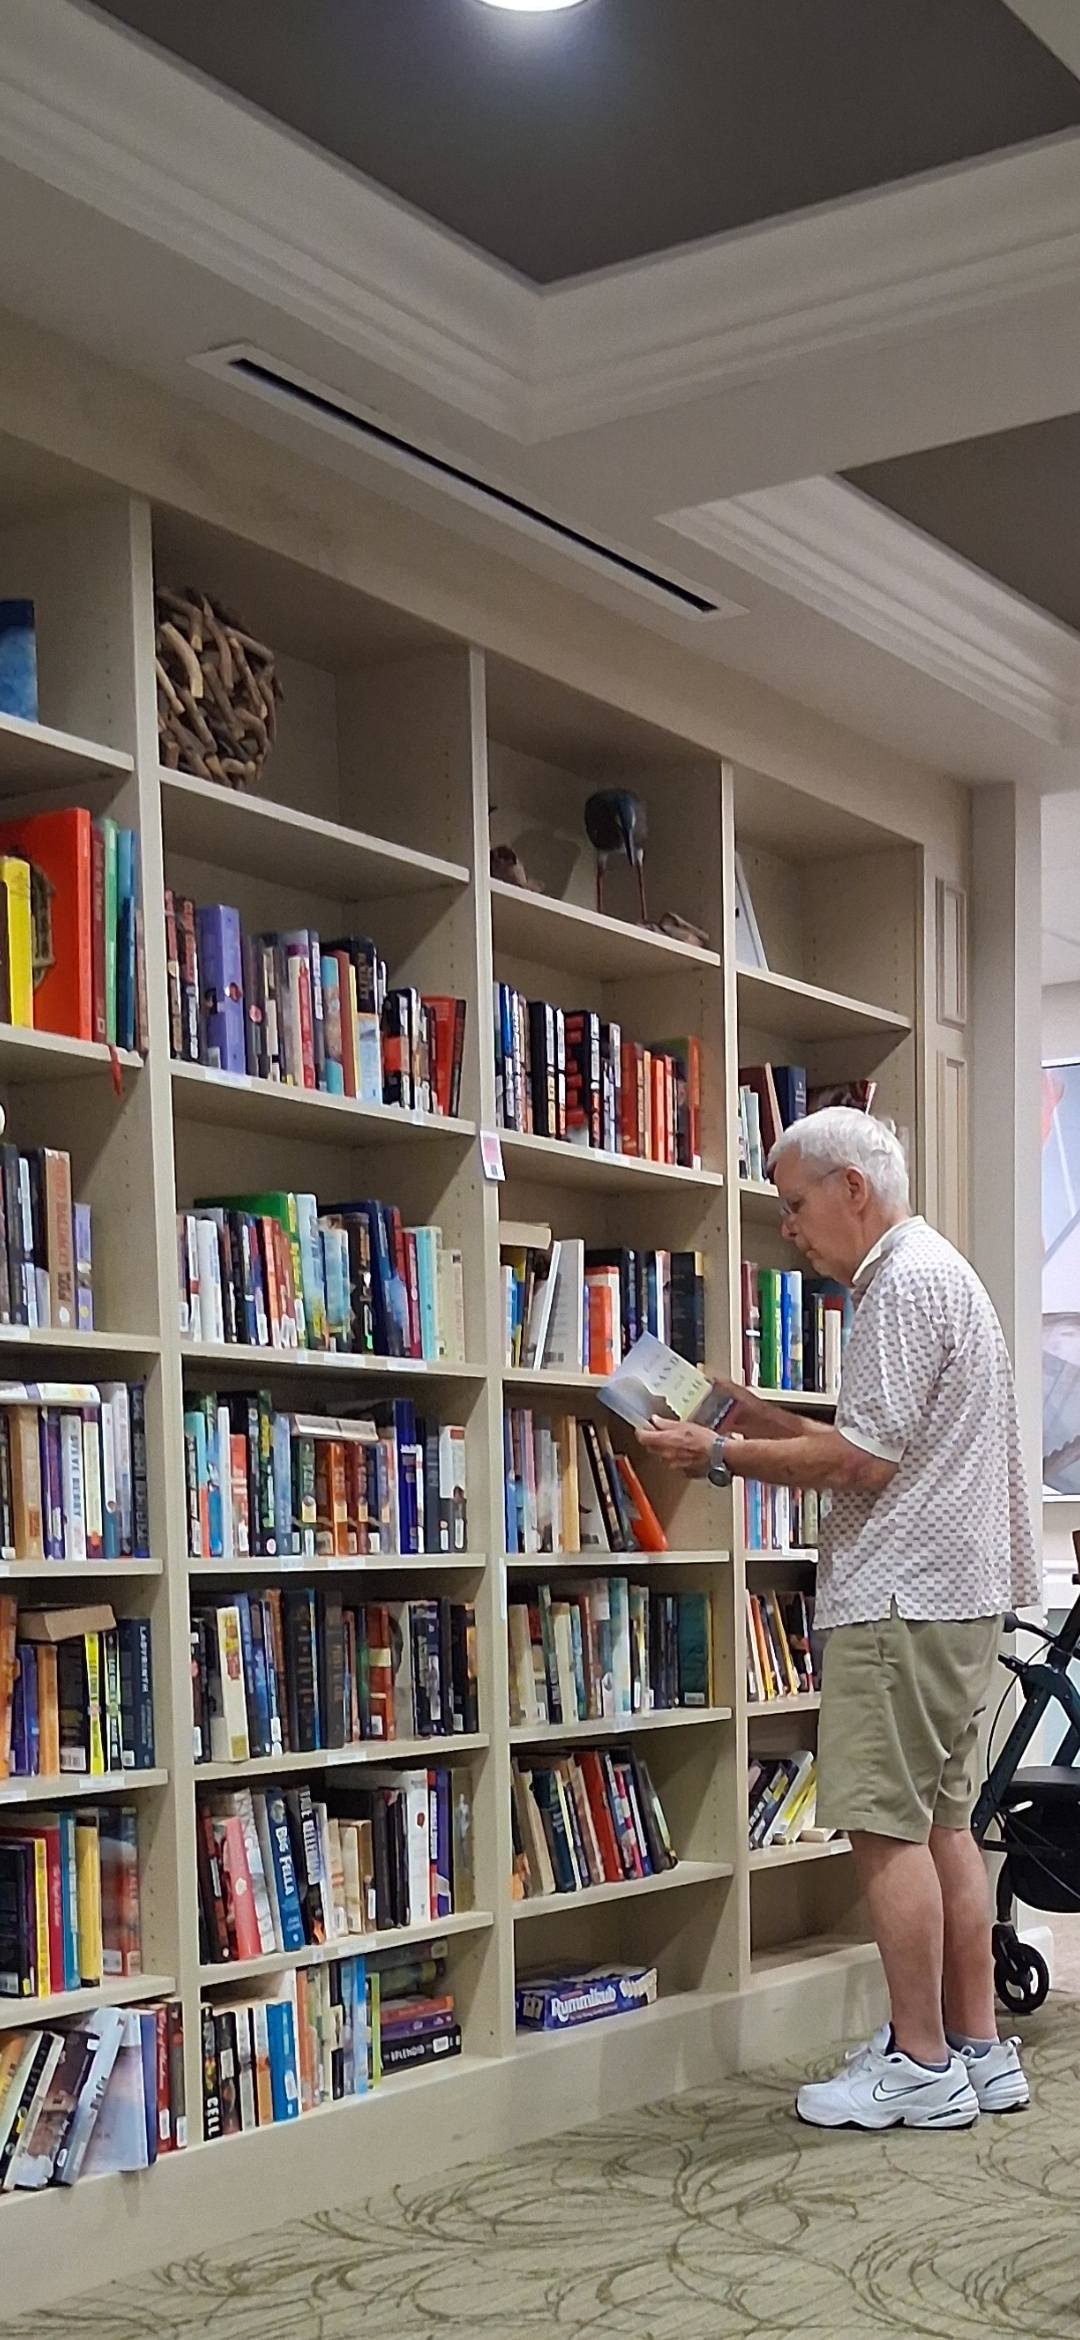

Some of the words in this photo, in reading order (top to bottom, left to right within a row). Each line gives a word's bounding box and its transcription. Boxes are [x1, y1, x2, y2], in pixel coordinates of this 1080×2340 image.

[139, 1625, 149, 1693] LABYRINTH
[275, 1825, 289, 1853] BIG
[279, 1855, 295, 1896] FELLA
[551, 1985, 616, 2022] Rummikub
[207, 2096, 220, 2137] CELL
